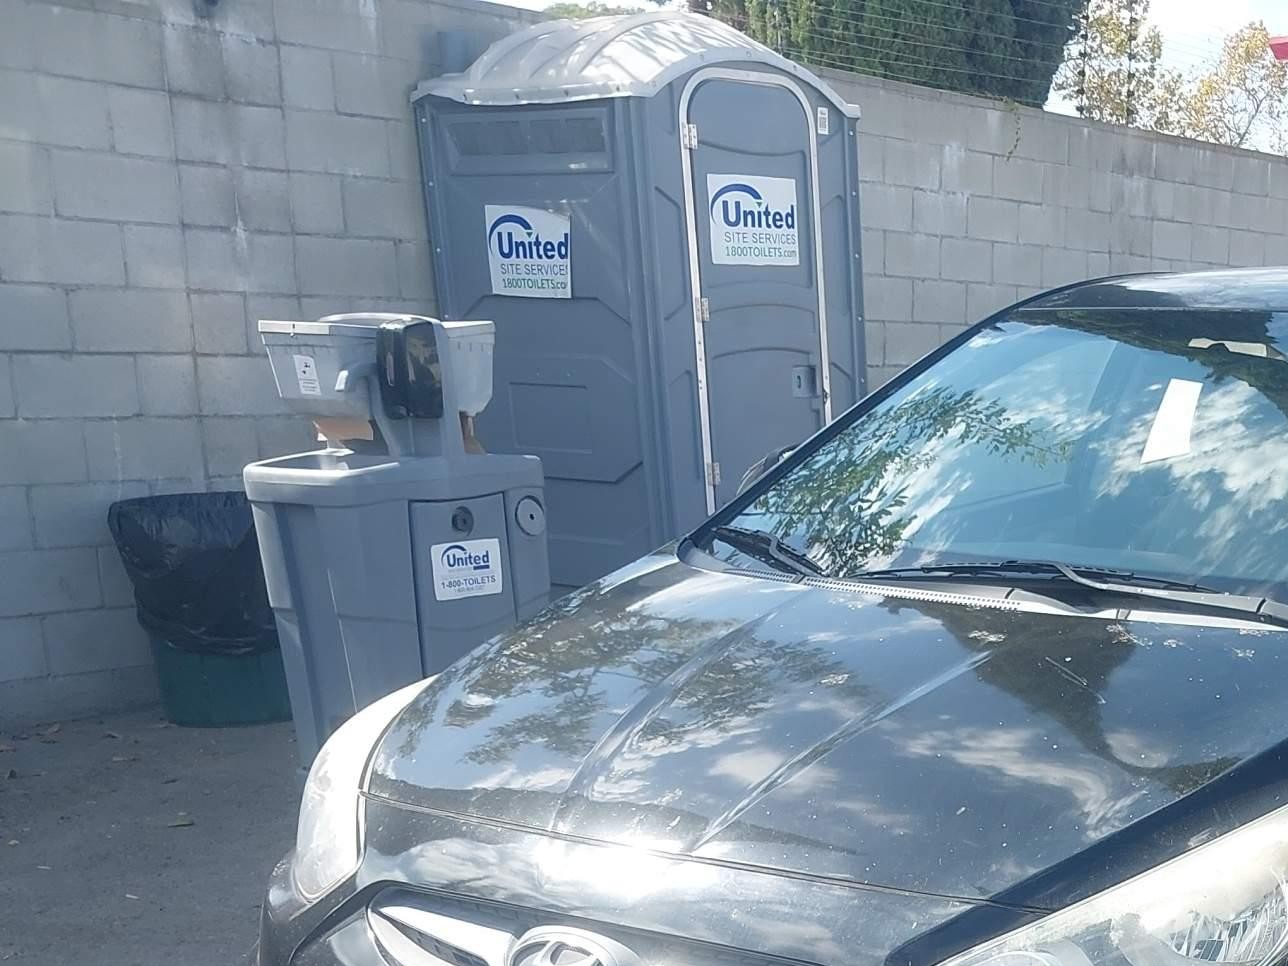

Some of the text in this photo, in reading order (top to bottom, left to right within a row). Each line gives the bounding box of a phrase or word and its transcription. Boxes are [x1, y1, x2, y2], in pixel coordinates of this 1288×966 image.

[722, 200, 795, 229] United
[497, 231, 568, 259] United
[724, 231, 796, 245] SITE SERVICES
[726, 246, 797, 258] 1800TOILETS.com
[500, 263, 521, 275] SITE
[446, 550, 490, 568] United
[441, 575, 496, 589] 1-800-TOILETS
